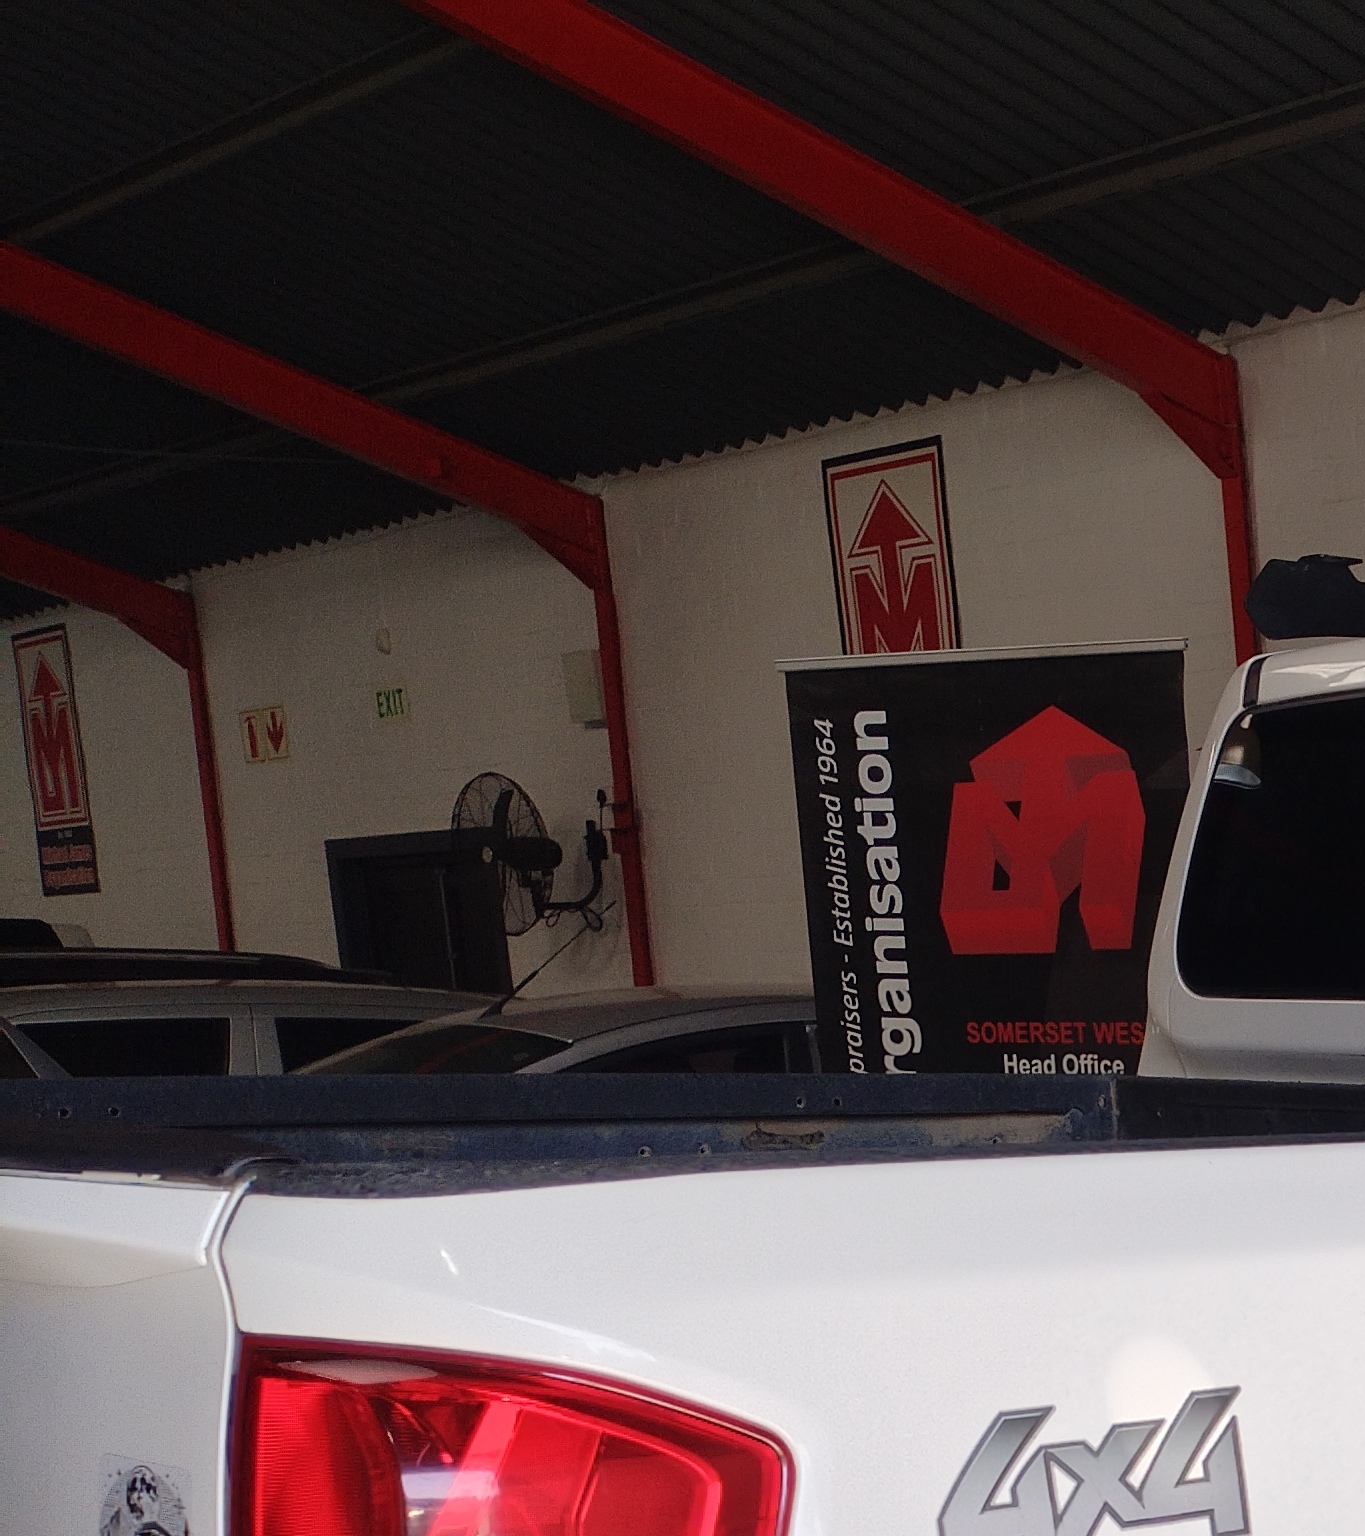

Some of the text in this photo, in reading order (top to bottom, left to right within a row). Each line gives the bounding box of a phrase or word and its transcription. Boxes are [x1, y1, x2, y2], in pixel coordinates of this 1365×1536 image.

[376, 688, 404, 718] EXIT
[814, 718, 839, 790] 1964
[823, 794, 855, 947] Established
[966, 1021, 1147, 1046] SOMERSET WES
[1003, 1053, 1125, 1075] Head Office
